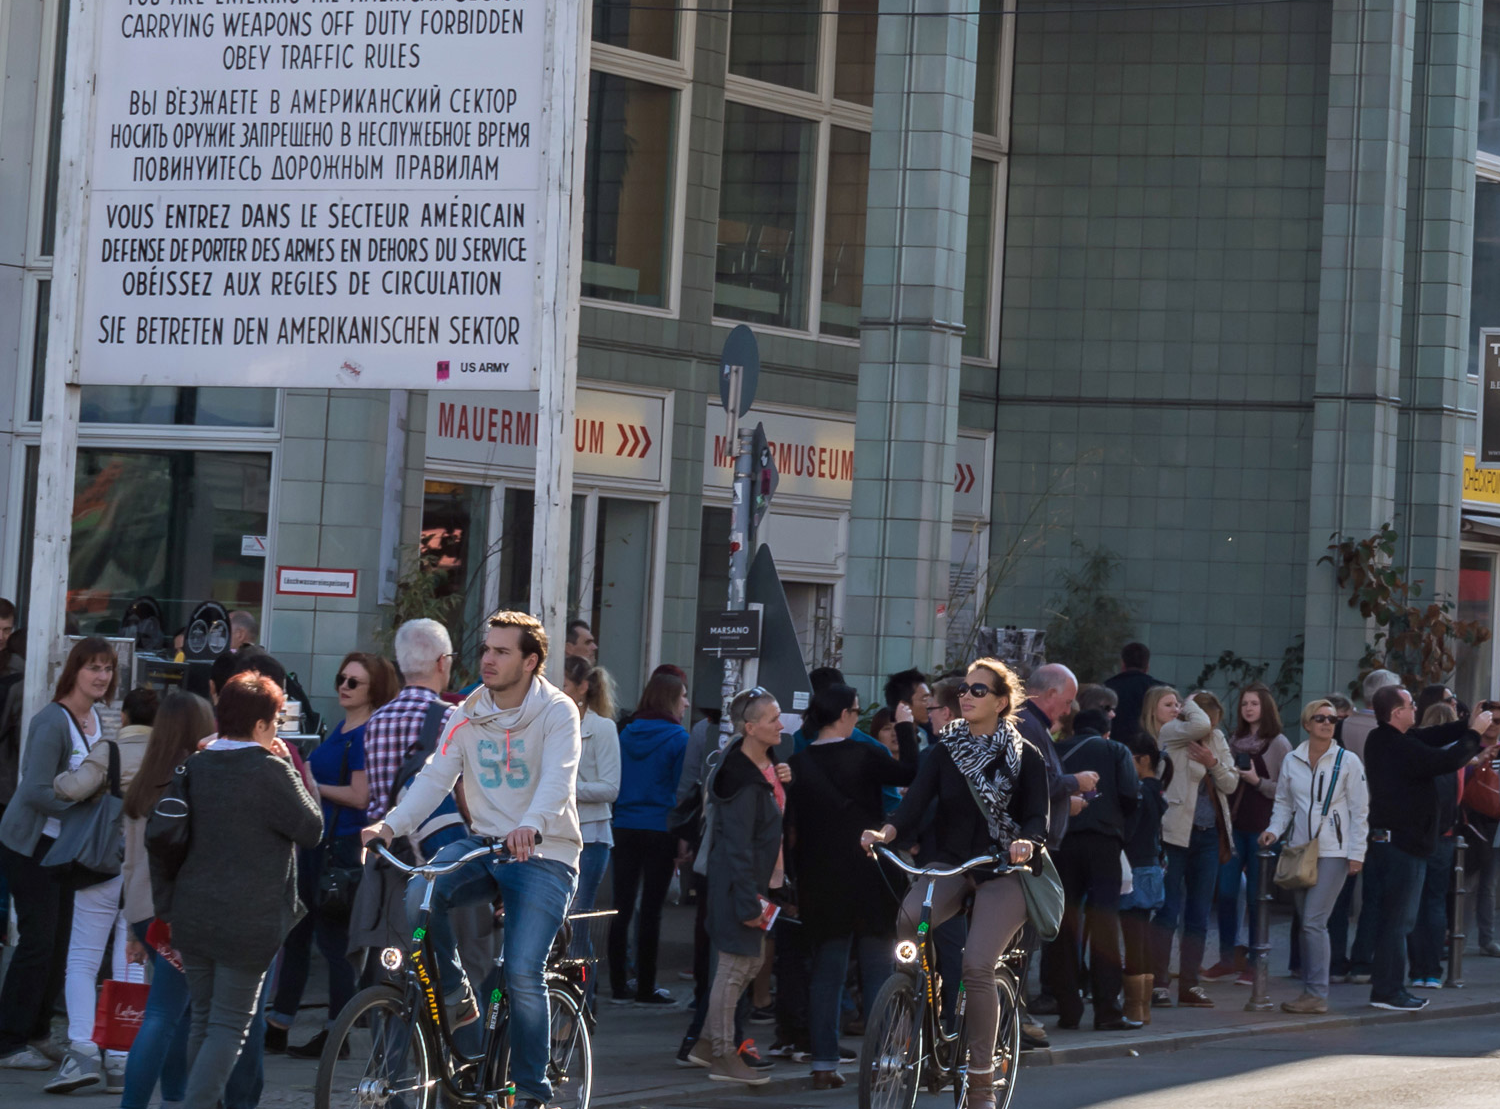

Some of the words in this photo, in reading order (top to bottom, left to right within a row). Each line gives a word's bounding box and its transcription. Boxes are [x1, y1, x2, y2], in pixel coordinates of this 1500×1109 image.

[121, 13, 214, 39] CARRYING
[222, 12, 312, 37] WEAPONS
[321, 11, 355, 36] OFF
[365, 10, 412, 36] DUTY
[420, 9, 524, 35] FORBIDDEN
[222, 45, 271, 71] OBEY
[281, 44, 354, 70] TRAFFIC
[364, 44, 420, 69] RULES
[129, 91, 157, 116] ВЫ
[290, 85, 441, 114] АМЕРИКАНСКИЙ
[449, 89, 517, 114] СЕКТОР
[110, 124, 168, 149] НОСИТЬ
[173, 123, 236, 149] ОРУЖИЕ
[358, 122, 472, 148] НЕСЛУЖЕБНОЕ
[477, 122, 530, 148] ВРЕМЯ
[270, 155, 384, 181] ДОРОЖНЫМ
[396, 155, 499, 181] ПРАВИЛАМ
[106, 204, 154, 229] VOUS
[165, 205, 231, 229] ENTREZ
[241, 204, 291, 229] DANS
[301, 204, 318, 228] LE
[328, 203, 409, 229] SECTEUR
[420, 195, 525, 228] AMÉRICAIN
[101, 238, 166, 263] DEFENSE
[169, 239, 189, 263] DE
[191, 238, 248, 263] PORTER
[251, 238, 281, 263] DES
[284, 238, 335, 262] ARMES
[340, 239, 361, 263] EN
[368, 238, 429, 263] DEHORS
[435, 238, 457, 262] DU
[461, 237, 527, 262] SERVICE
[122, 266, 213, 296] OBÉISSEZ
[223, 272, 262, 296] AUX
[271, 271, 338, 296] REGLES
[348, 272, 371, 296] DE
[381, 271, 501, 296] CIRCULATION
[98, 316, 127, 344] SIE
[136, 317, 224, 345] BETRETEN
[233, 318, 269, 346] DEN
[276, 316, 440, 345] AMERIKANISCHEN
[448, 316, 520, 345] SEKTOR
[460, 363, 477, 373] US
[478, 363, 510, 373] ARMY
[438, 402, 604, 454] MAUERMUM
[709, 626, 750, 635] MARSANO
[489, 1002, 500, 1030] BERLIN
